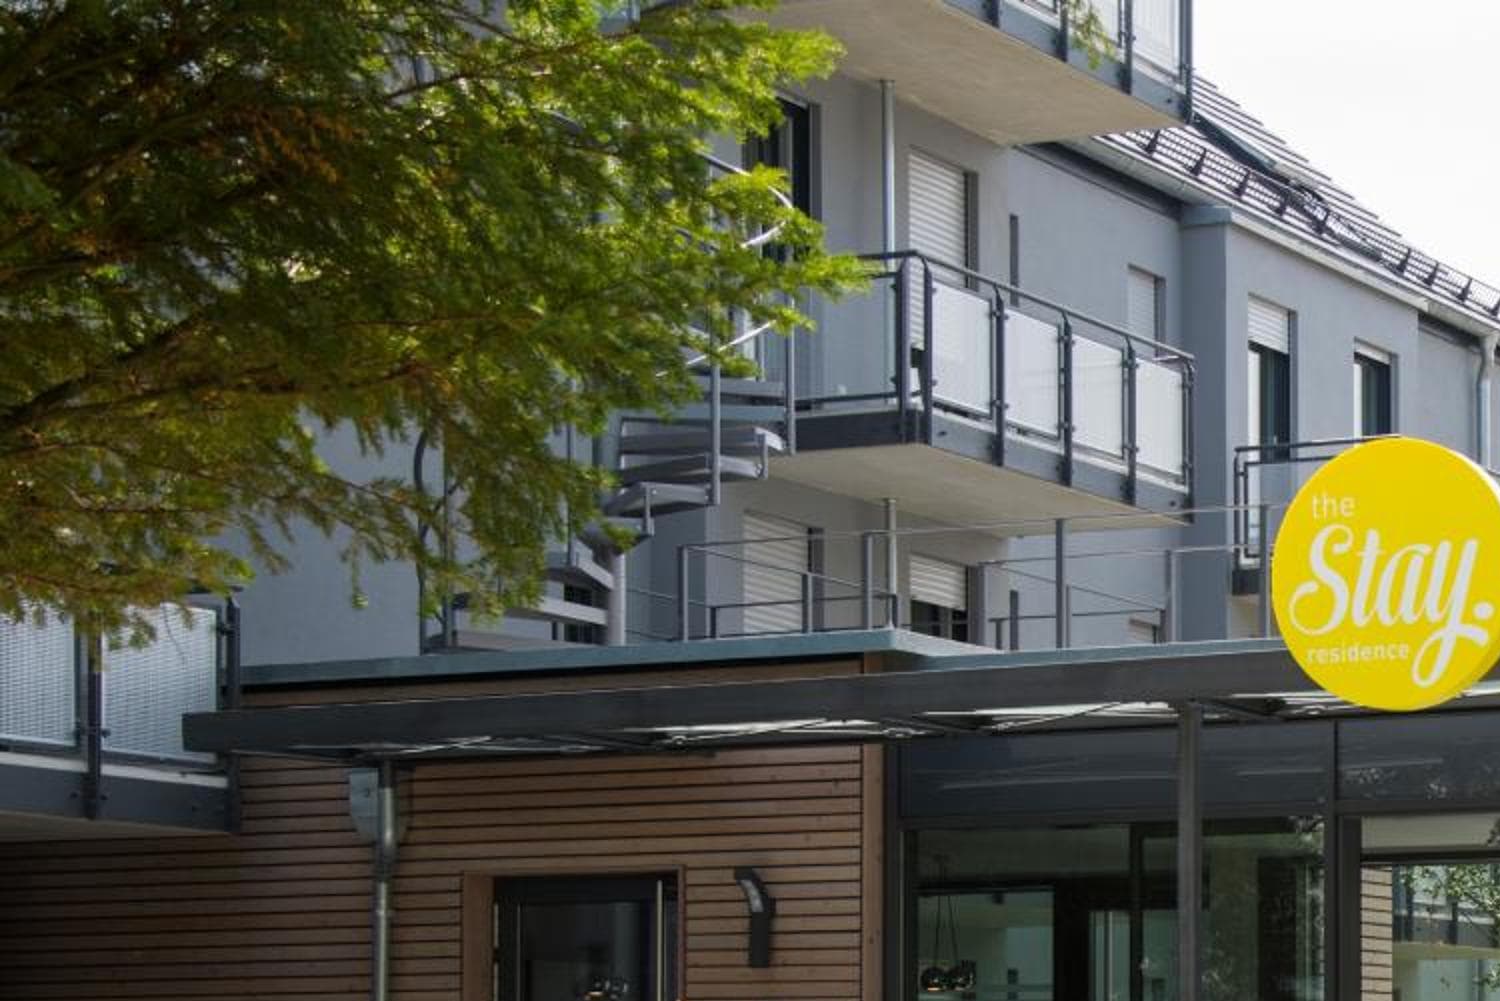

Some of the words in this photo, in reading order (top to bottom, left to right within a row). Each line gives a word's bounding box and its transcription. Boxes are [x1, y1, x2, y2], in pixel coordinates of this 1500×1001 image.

[1312, 493, 1354, 518] the
[1290, 523, 1494, 688] Stay.
[1308, 643, 1409, 664] residence
